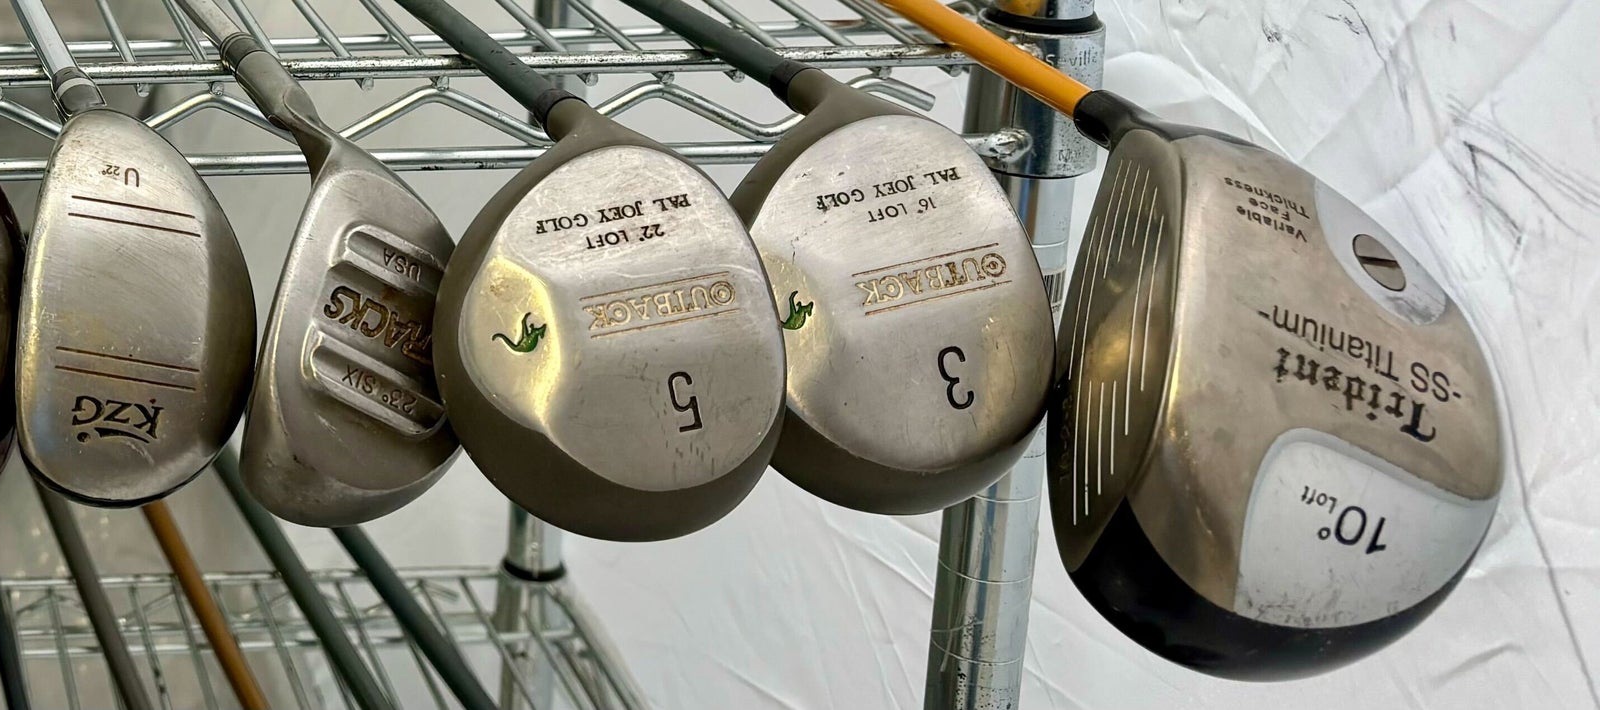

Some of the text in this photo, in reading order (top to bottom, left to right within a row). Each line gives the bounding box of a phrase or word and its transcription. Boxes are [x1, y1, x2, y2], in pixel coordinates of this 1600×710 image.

[124, 168, 140, 188] U
[816, 166, 961, 211] PAL JOEY GOLF
[1224, 177, 1311, 219] Thickness
[535, 193, 691, 235] PAL JOEY GOLF
[867, 203, 907, 223] LOFT
[1236, 205, 1308, 243] Variable
[1248, 197, 1290, 222] Face
[586, 229, 629, 250] LOFT
[383, 247, 421, 283] USA
[855, 252, 1007, 306] OUTBACK
[582, 280, 737, 331] OUTBACK
[342, 364, 377, 395] SIX
[937, 345, 975, 410] 3
[1273, 347, 1436, 442] Trident
[71, 395, 164, 440] KZG
[667, 371, 703, 433] 5
[1300, 485, 1387, 555] 10° Loft
